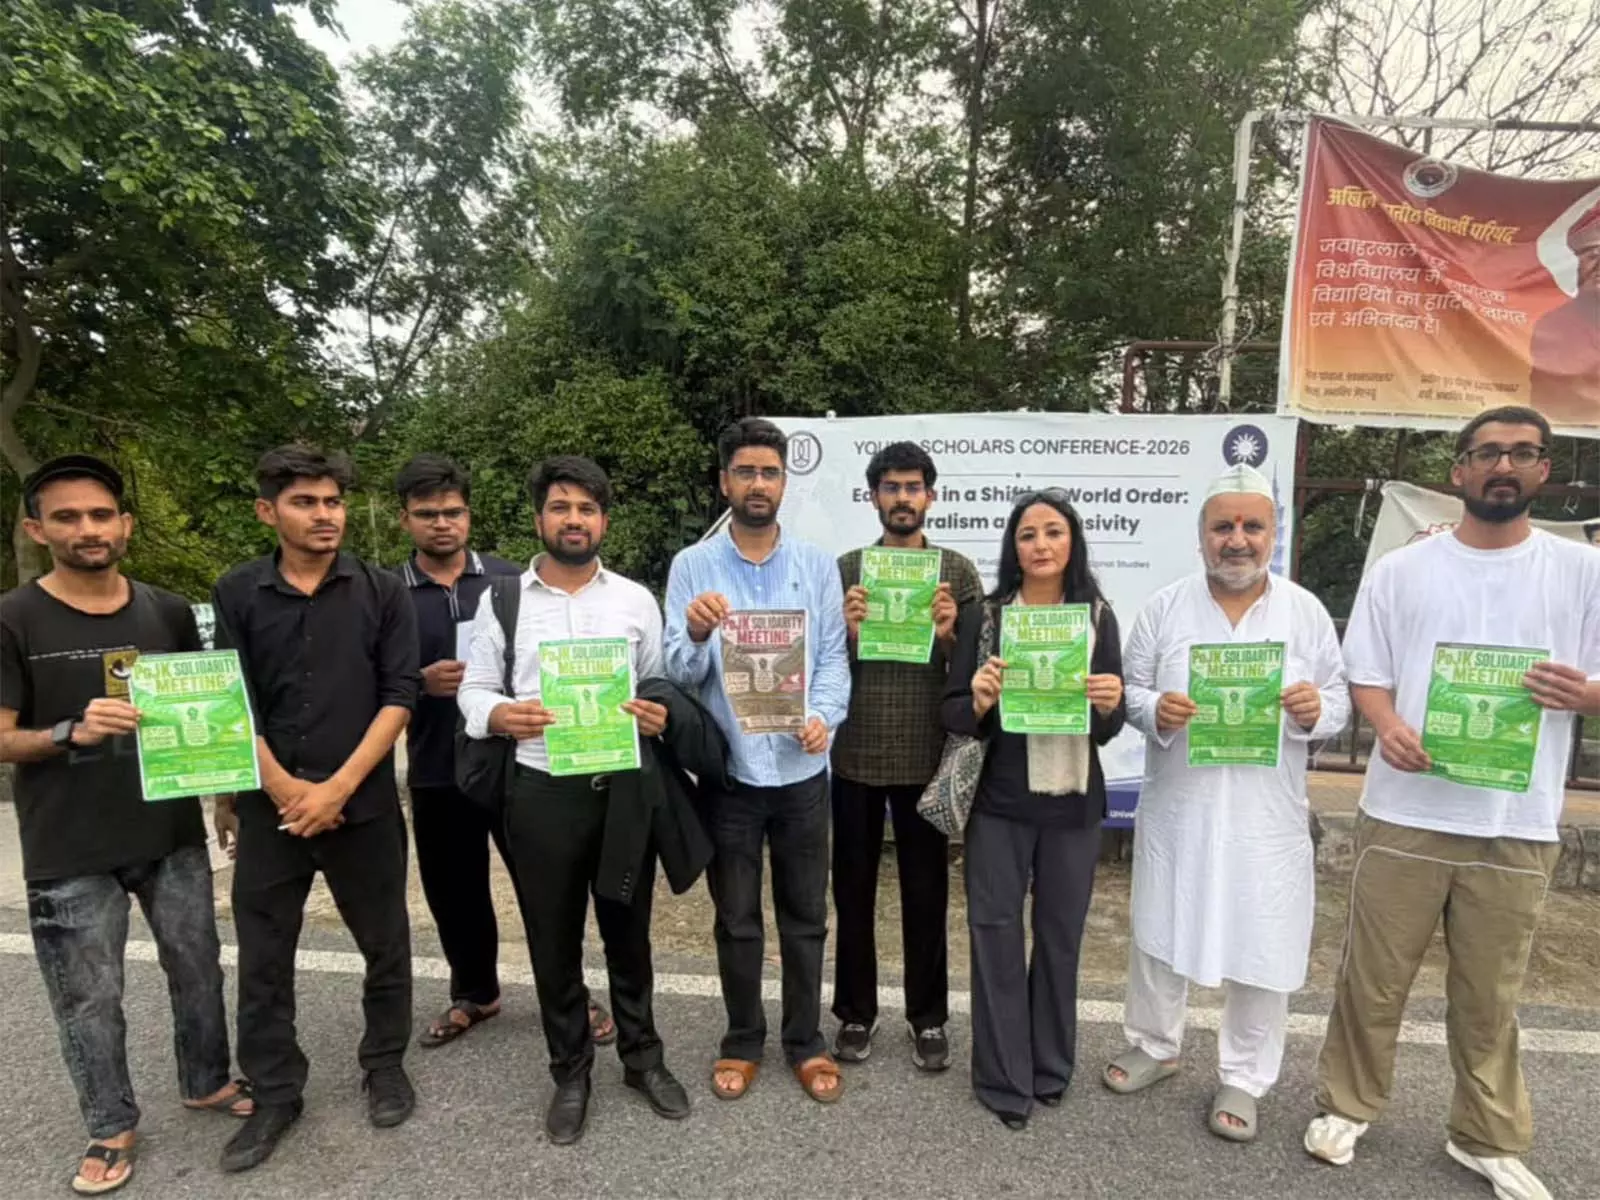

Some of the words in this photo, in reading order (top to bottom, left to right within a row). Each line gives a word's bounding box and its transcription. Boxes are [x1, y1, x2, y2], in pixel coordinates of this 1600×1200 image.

[920, 439, 1015, 454] SCHOLARS
[1019, 439, 1191, 455] CONFERENCE-2026
[942, 486, 960, 501] in
[964, 489, 976, 501] a
[1126, 487, 1189, 504] Order:
[926, 512, 988, 529] ralism
[174, 657, 235, 676] SOLIDARITY
[156, 674, 225, 692] MEETING
